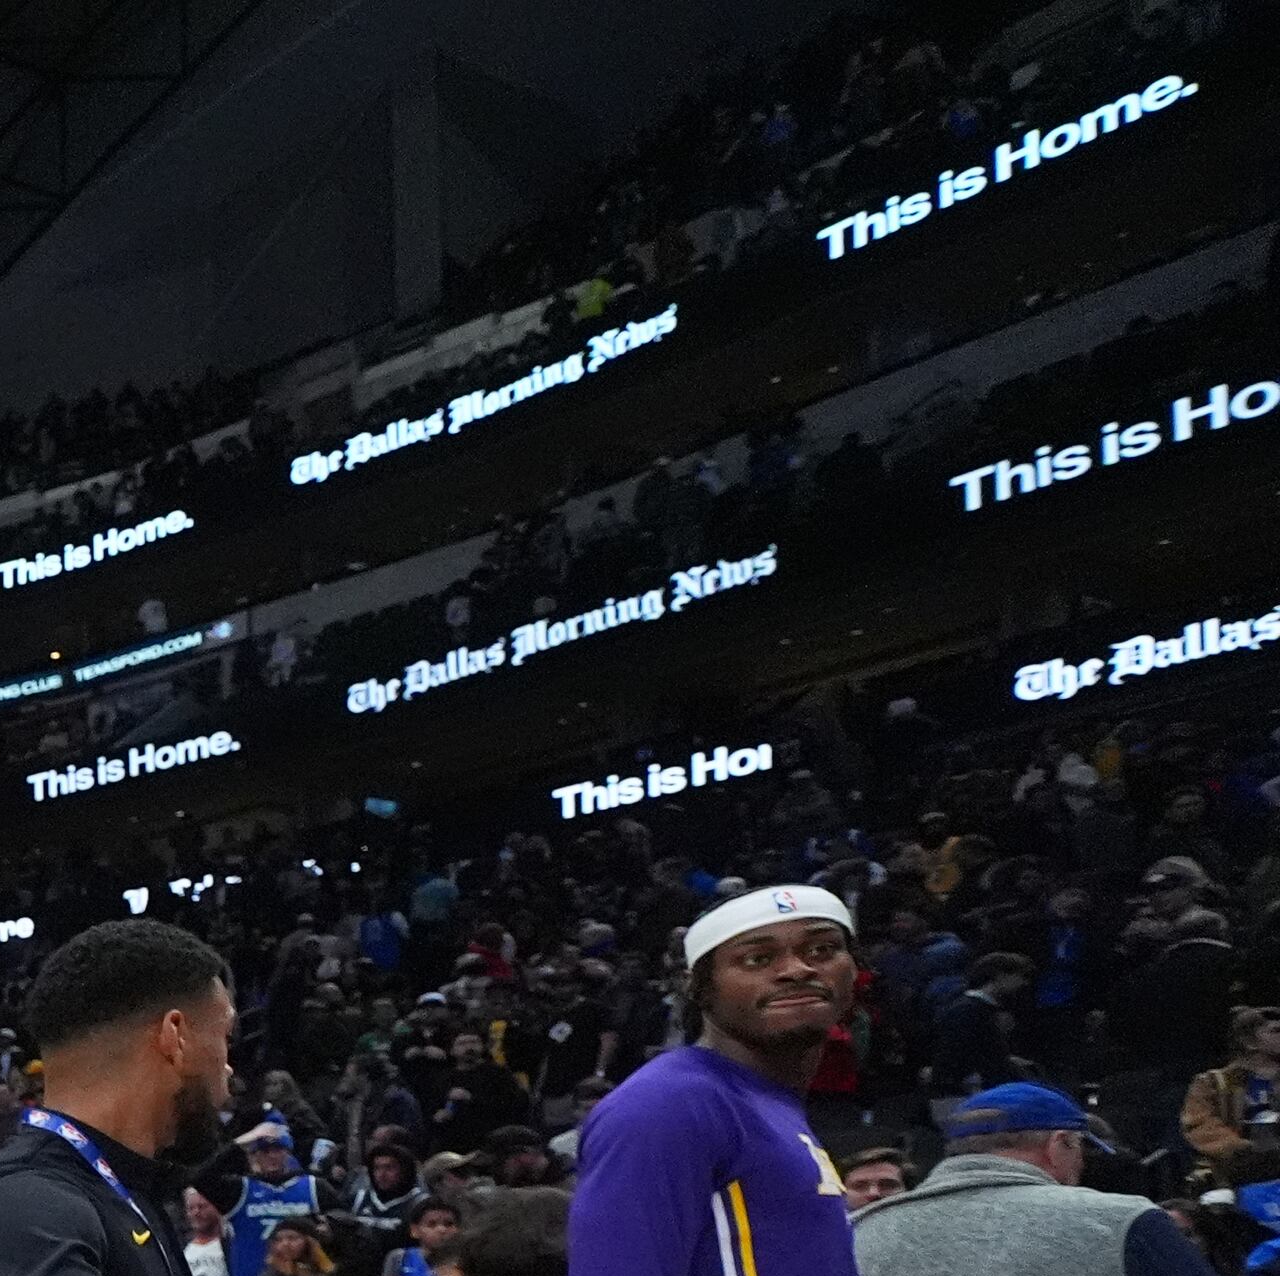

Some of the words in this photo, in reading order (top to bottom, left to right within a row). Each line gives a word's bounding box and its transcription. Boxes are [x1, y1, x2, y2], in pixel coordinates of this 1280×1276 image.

[816, 192, 932, 259] This
[938, 167, 987, 209] is
[994, 76, 1198, 183] Home.
[344, 408, 444, 471] Dallas
[448, 352, 585, 434] Morning
[587, 303, 677, 373] News
[949, 445, 1092, 511] This
[1101, 422, 1161, 465] is
[64, 544, 91, 571] is
[93, 510, 194, 561] Home.
[403, 637, 505, 700] Dallas
[511, 589, 665, 666] Morning
[670, 544, 777, 611] News
[1013, 658, 1104, 700] The
[27, 765, 94, 801] This
[97, 756, 125, 785] is
[129, 731, 241, 777] Home.
[552, 775, 644, 819] This
[647, 764, 687, 797] is
